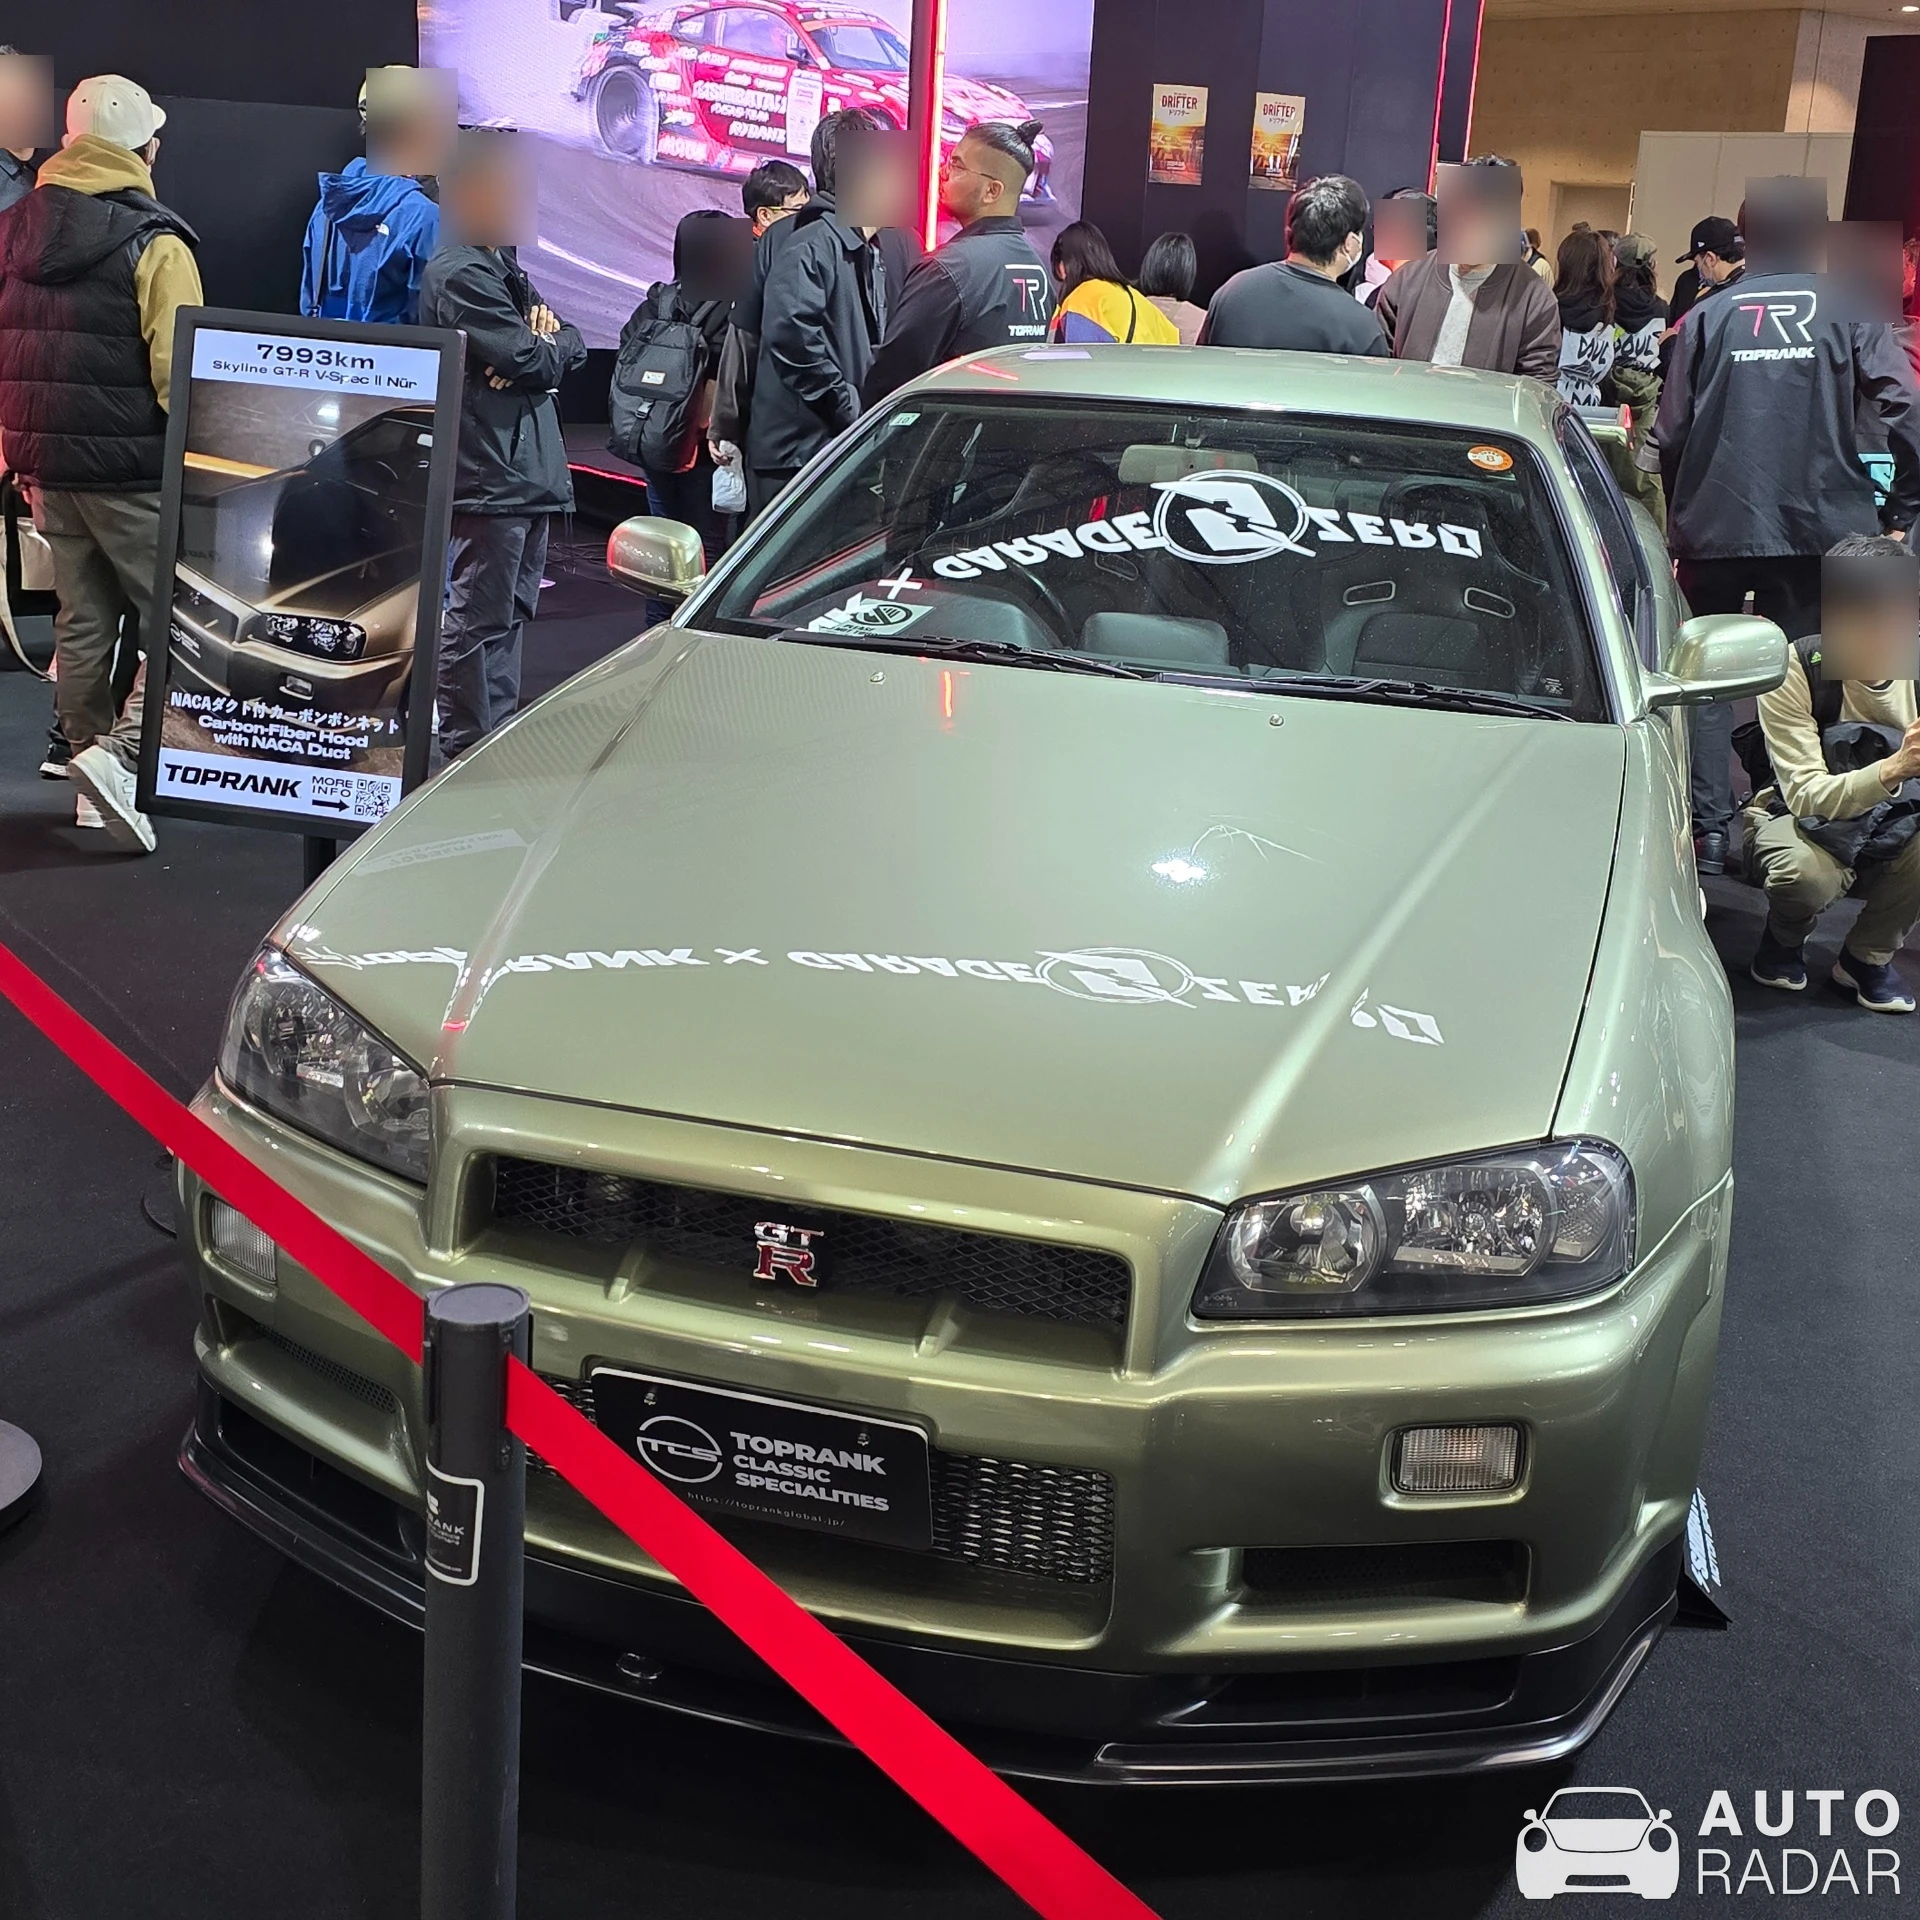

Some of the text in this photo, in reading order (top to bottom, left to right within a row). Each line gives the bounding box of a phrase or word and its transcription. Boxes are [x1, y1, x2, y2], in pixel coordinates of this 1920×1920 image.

[1161, 95, 1198, 110] DRIFTER
[257, 343, 376, 370] 7993km
[1731, 346, 1816, 362] TOPRANK
[212, 360, 268, 375] Skyline
[273, 366, 310, 379] GT-R
[315, 370, 370, 386] V-Spec
[387, 376, 418, 390] Nür
[198, 714, 369, 748] Carbon-Fiber Hood
[213, 732, 352, 760] with NACA Duct
[164, 762, 302, 799] TOPRANK
[311, 775, 354, 789] MORE
[312, 785, 352, 798] INFO
[730, 1431, 887, 1475] TOPRANK
[732, 1454, 831, 1483] CLASSIC
[735, 1472, 889, 1512] SPECIALITIES
